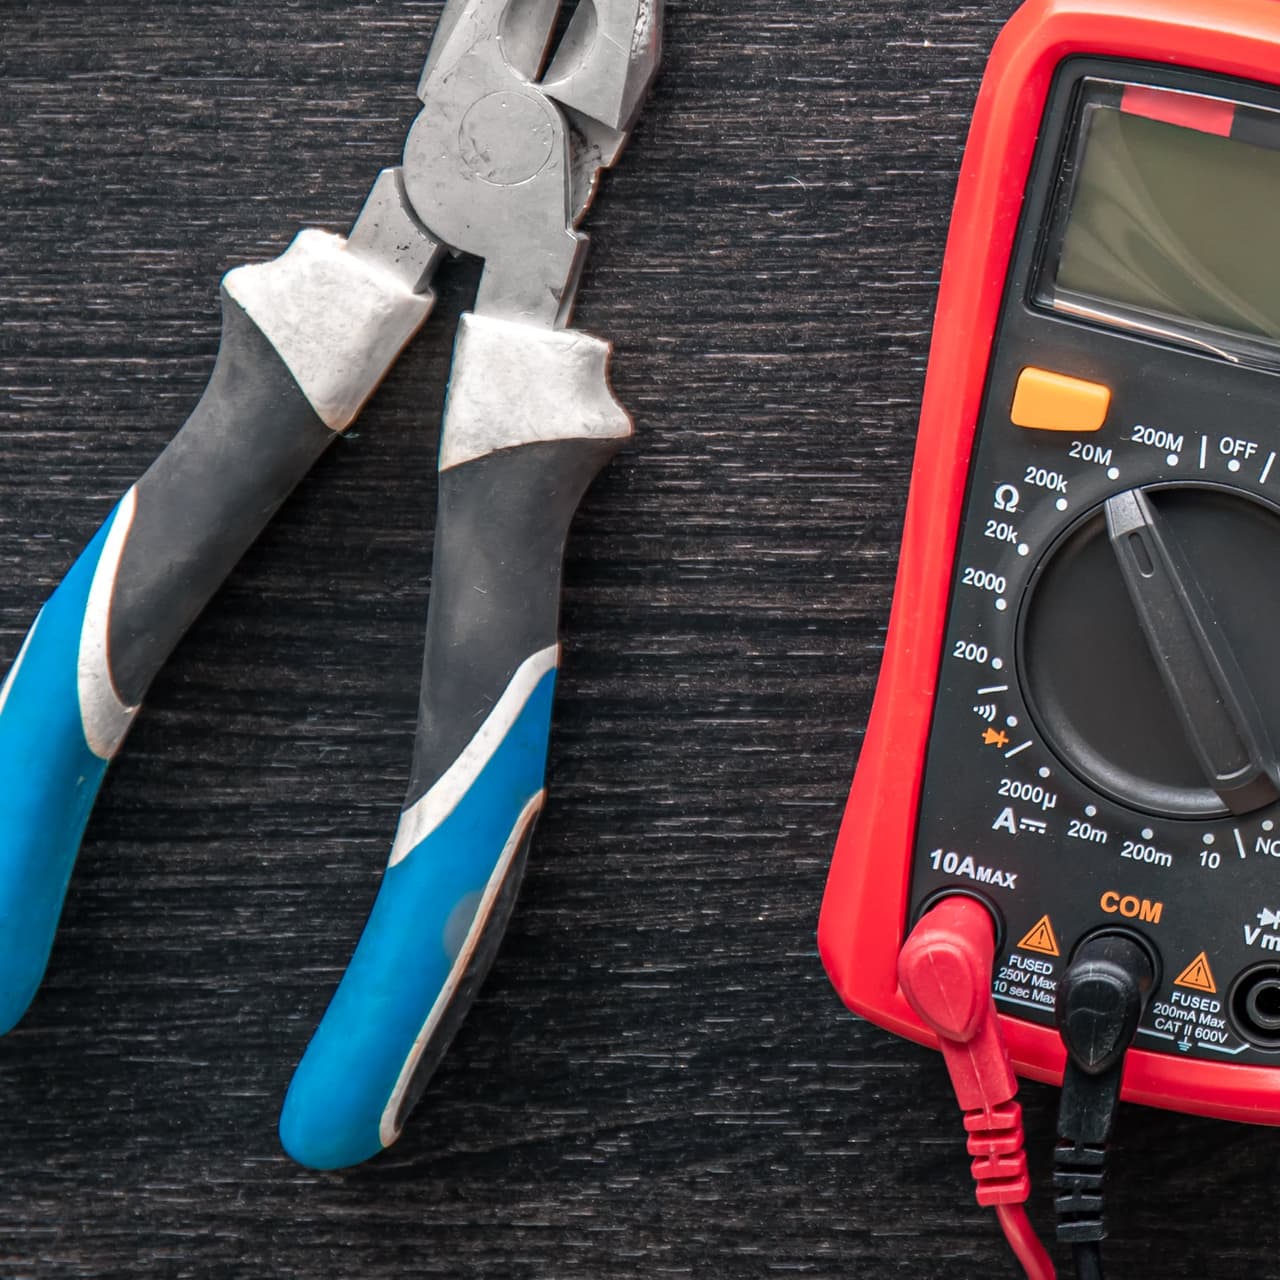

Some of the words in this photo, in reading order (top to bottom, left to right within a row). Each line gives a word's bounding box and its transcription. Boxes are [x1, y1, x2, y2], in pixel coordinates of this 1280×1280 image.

[1132, 426, 1183, 452] 200M
[1220, 437, 1258, 458] OFF
[1069, 442, 1112, 466] 20M
[1024, 467, 1067, 493] 200k
[994, 485, 1019, 512] Ω
[985, 520, 1017, 543] 20k
[963, 568, 1006, 593] 2000
[953, 641, 987, 663] 200
[1068, 820, 1107, 843] 20m
[1121, 841, 1172, 867] 200m
[1200, 851, 1220, 868] 10
[1100, 891, 1165, 923] COM
[1009, 954, 1053, 975] FUSED
[998, 967, 1030, 983] 250V
[1031, 974, 1057, 991] Max
[993, 980, 1008, 993] 10
[1009, 986, 1030, 998] sec
[1032, 989, 1056, 1005] Max
[1171, 991, 1220, 1013] FUSED
[1153, 1002, 1197, 1023] 200mA
[1198, 1013, 1226, 1029] Max
[1154, 1018, 1182, 1033] CAT
[1184, 1024, 1193, 1037] II
[1194, 1027, 1228, 1044] 600V
